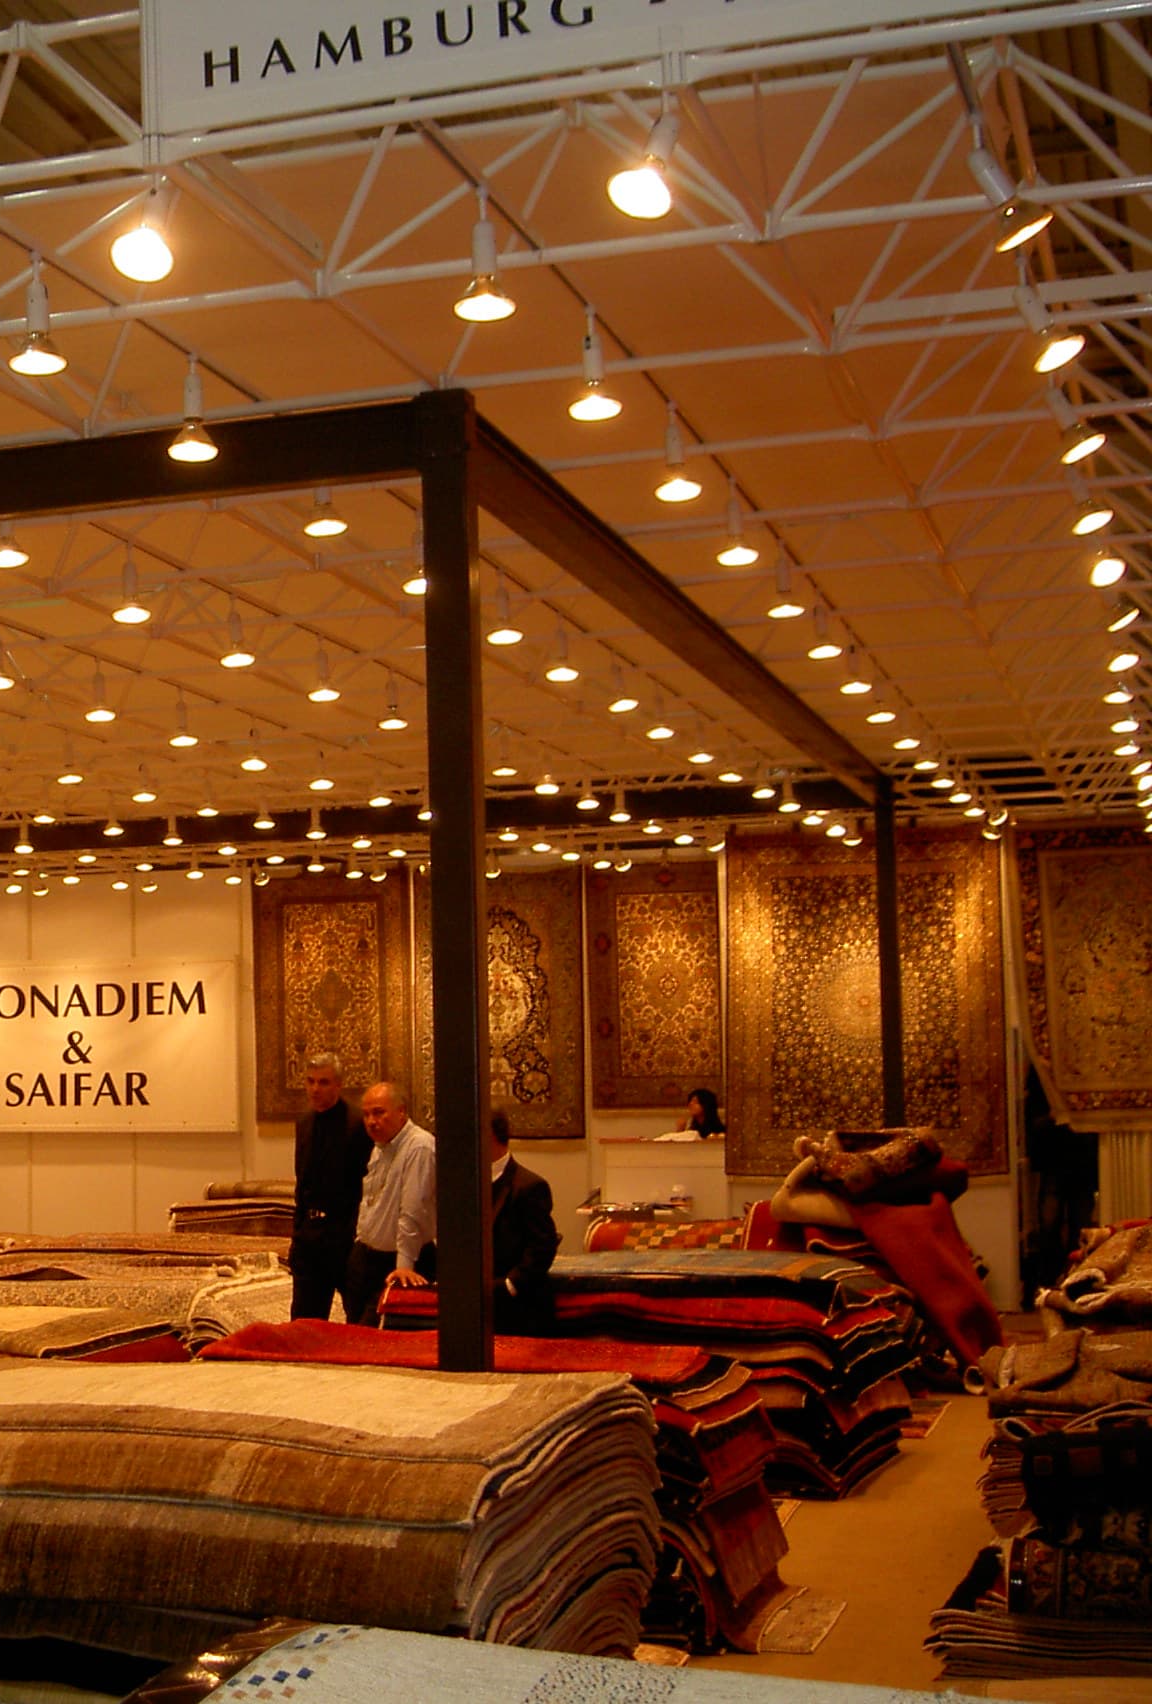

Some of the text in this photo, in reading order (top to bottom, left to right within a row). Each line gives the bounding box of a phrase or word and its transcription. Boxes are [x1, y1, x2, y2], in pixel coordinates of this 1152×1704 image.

[202, 0, 595, 88] HAMBURG
[62, 1031, 93, 1065] &
[5, 1072, 150, 1108] SAIFAR
